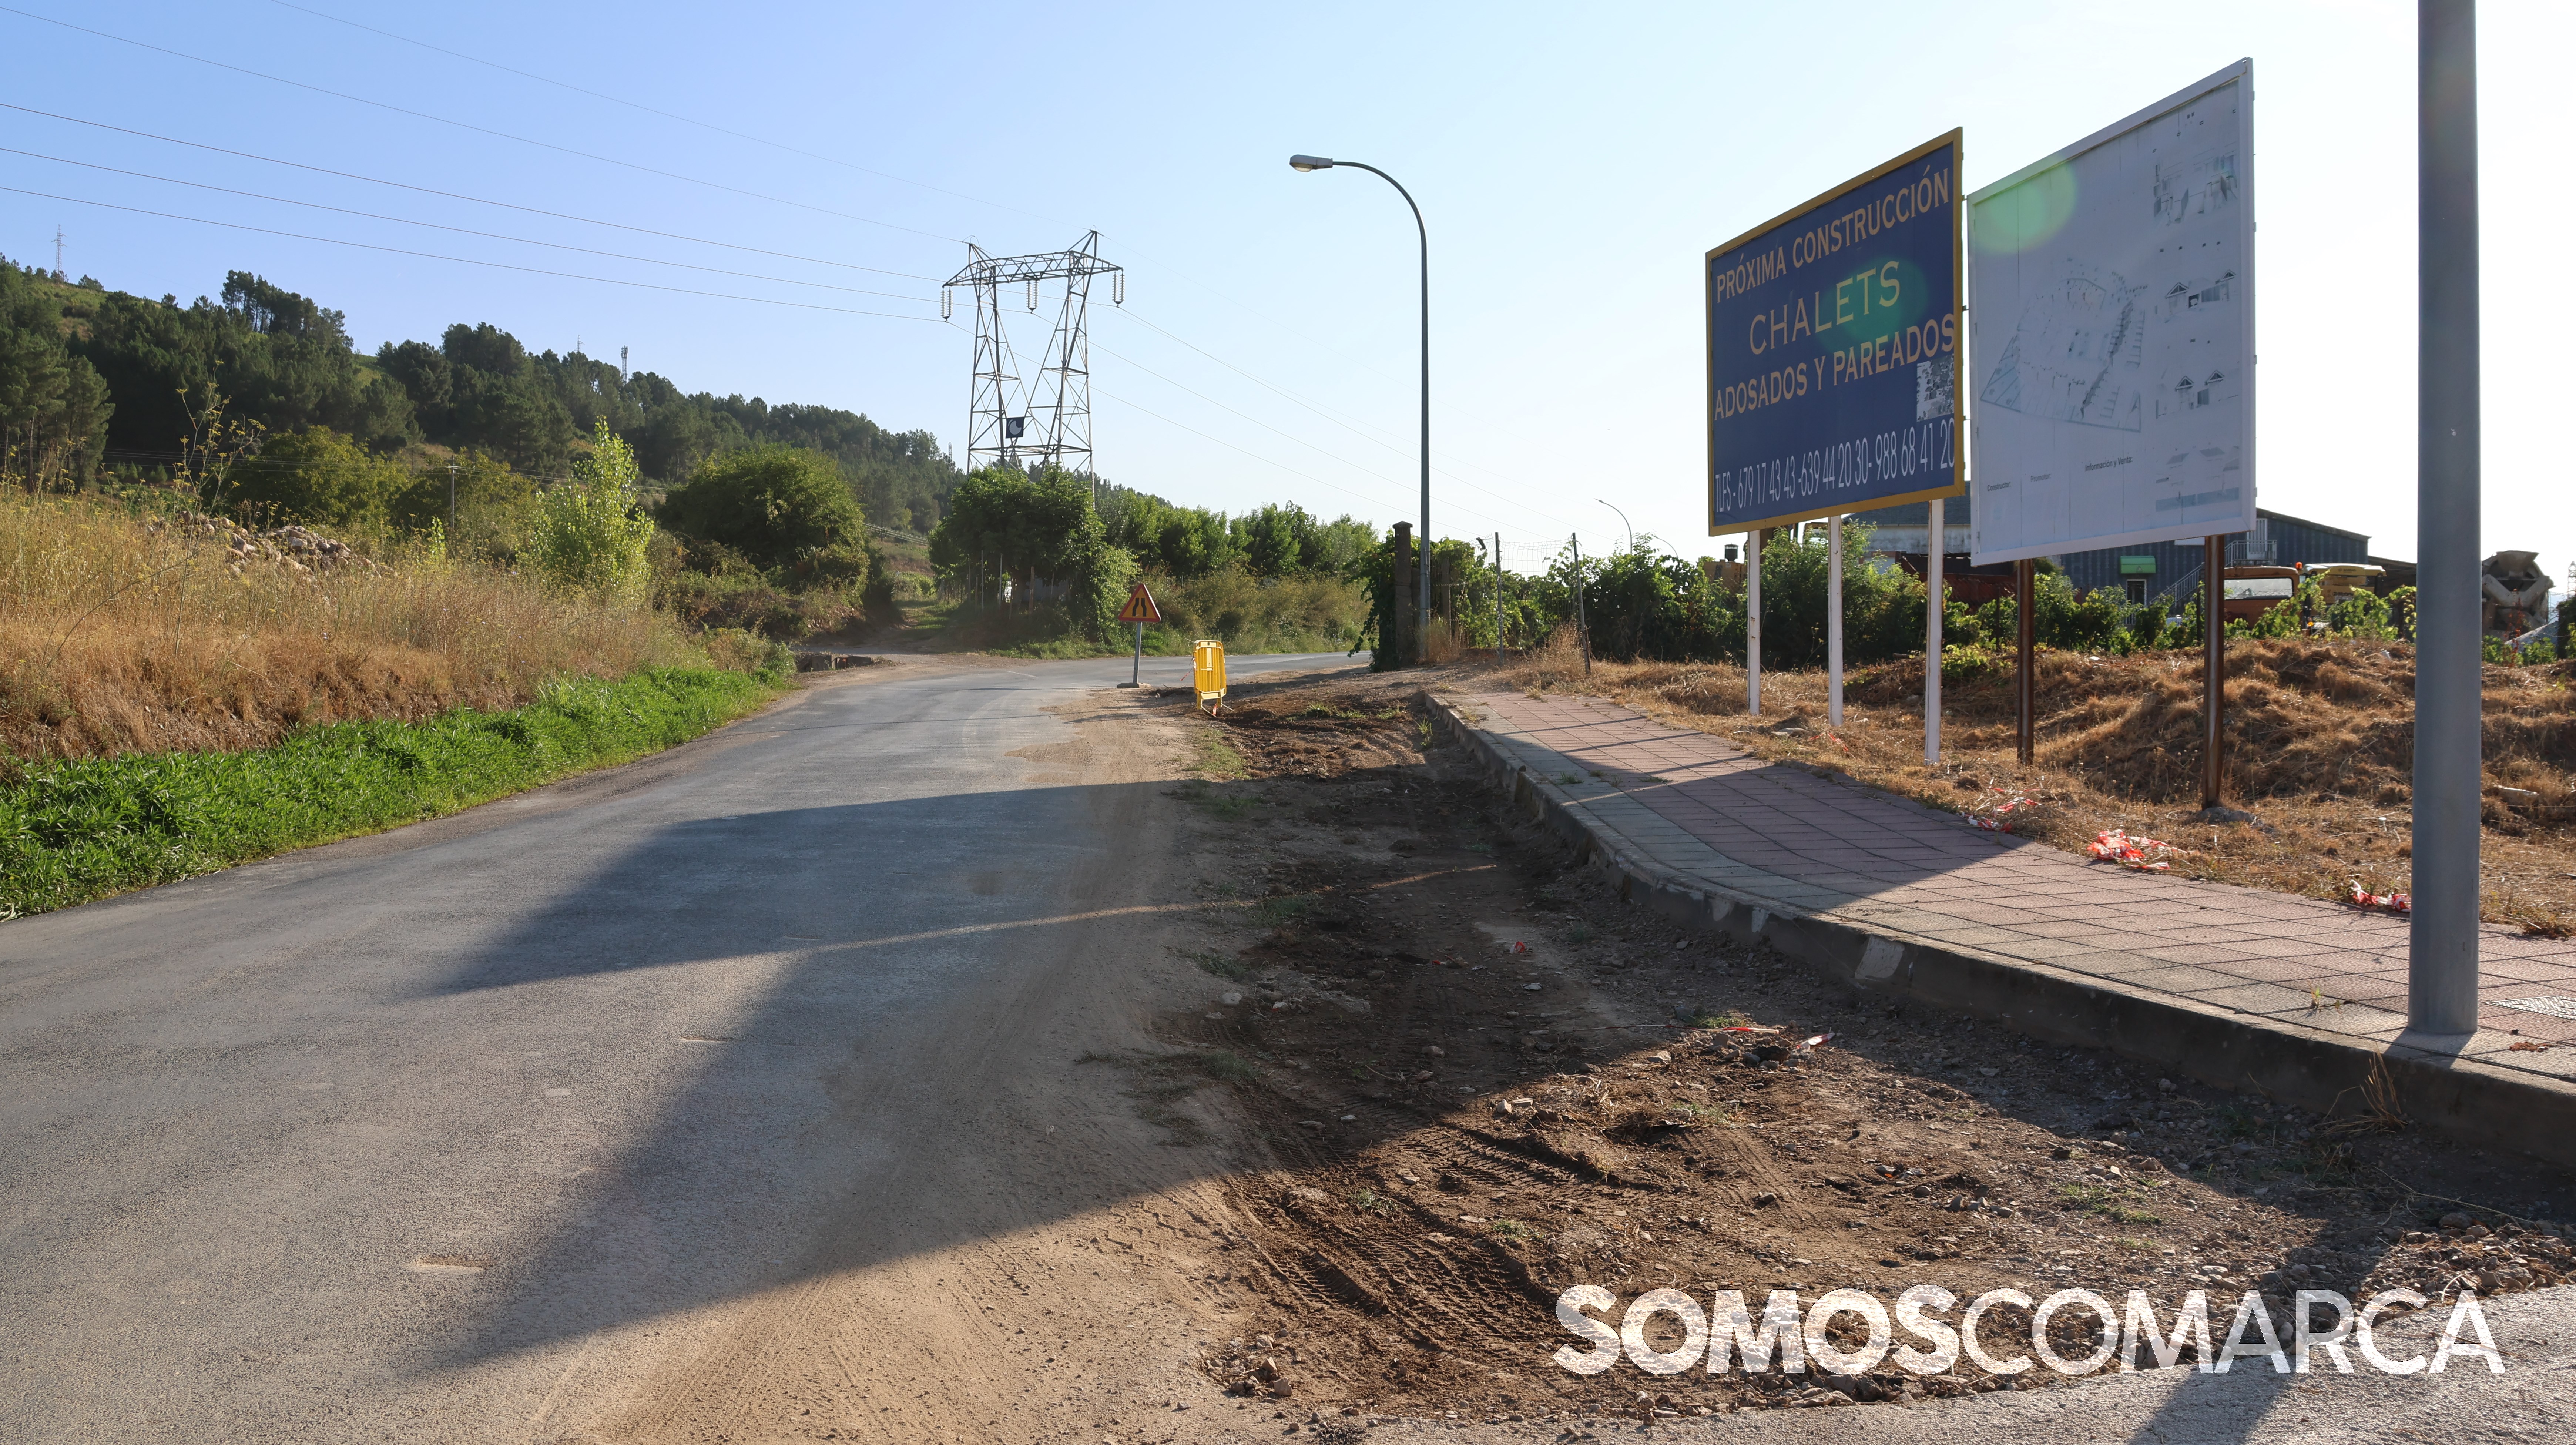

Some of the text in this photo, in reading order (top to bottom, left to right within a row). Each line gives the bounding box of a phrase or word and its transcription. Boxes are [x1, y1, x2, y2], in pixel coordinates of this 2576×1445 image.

[1717, 165, 1949, 303] PRÓXIMA CONSTRUCCIÓN
[1750, 261, 1900, 355] CHALETS
[1714, 314, 1954, 421] ADOSADOS Y PAREADOS
[1715, 471, 1731, 512] TLFS
[1738, 466, 1754, 509] 679
[1757, 462, 1766, 504] 17
[1769, 459, 1781, 501] 43
[1784, 455, 1795, 499] 43
[1822, 445, 1835, 490] 44
[1838, 441, 1851, 488] 20
[1875, 431, 1897, 481] 988
[1901, 426, 1916, 476] 68
[1920, 423, 1933, 472] 41
[1940, 417, 1955, 469] 20
[1987, 482, 2012, 492] Constructor:
[2117, 457, 2133, 465] Venta:
